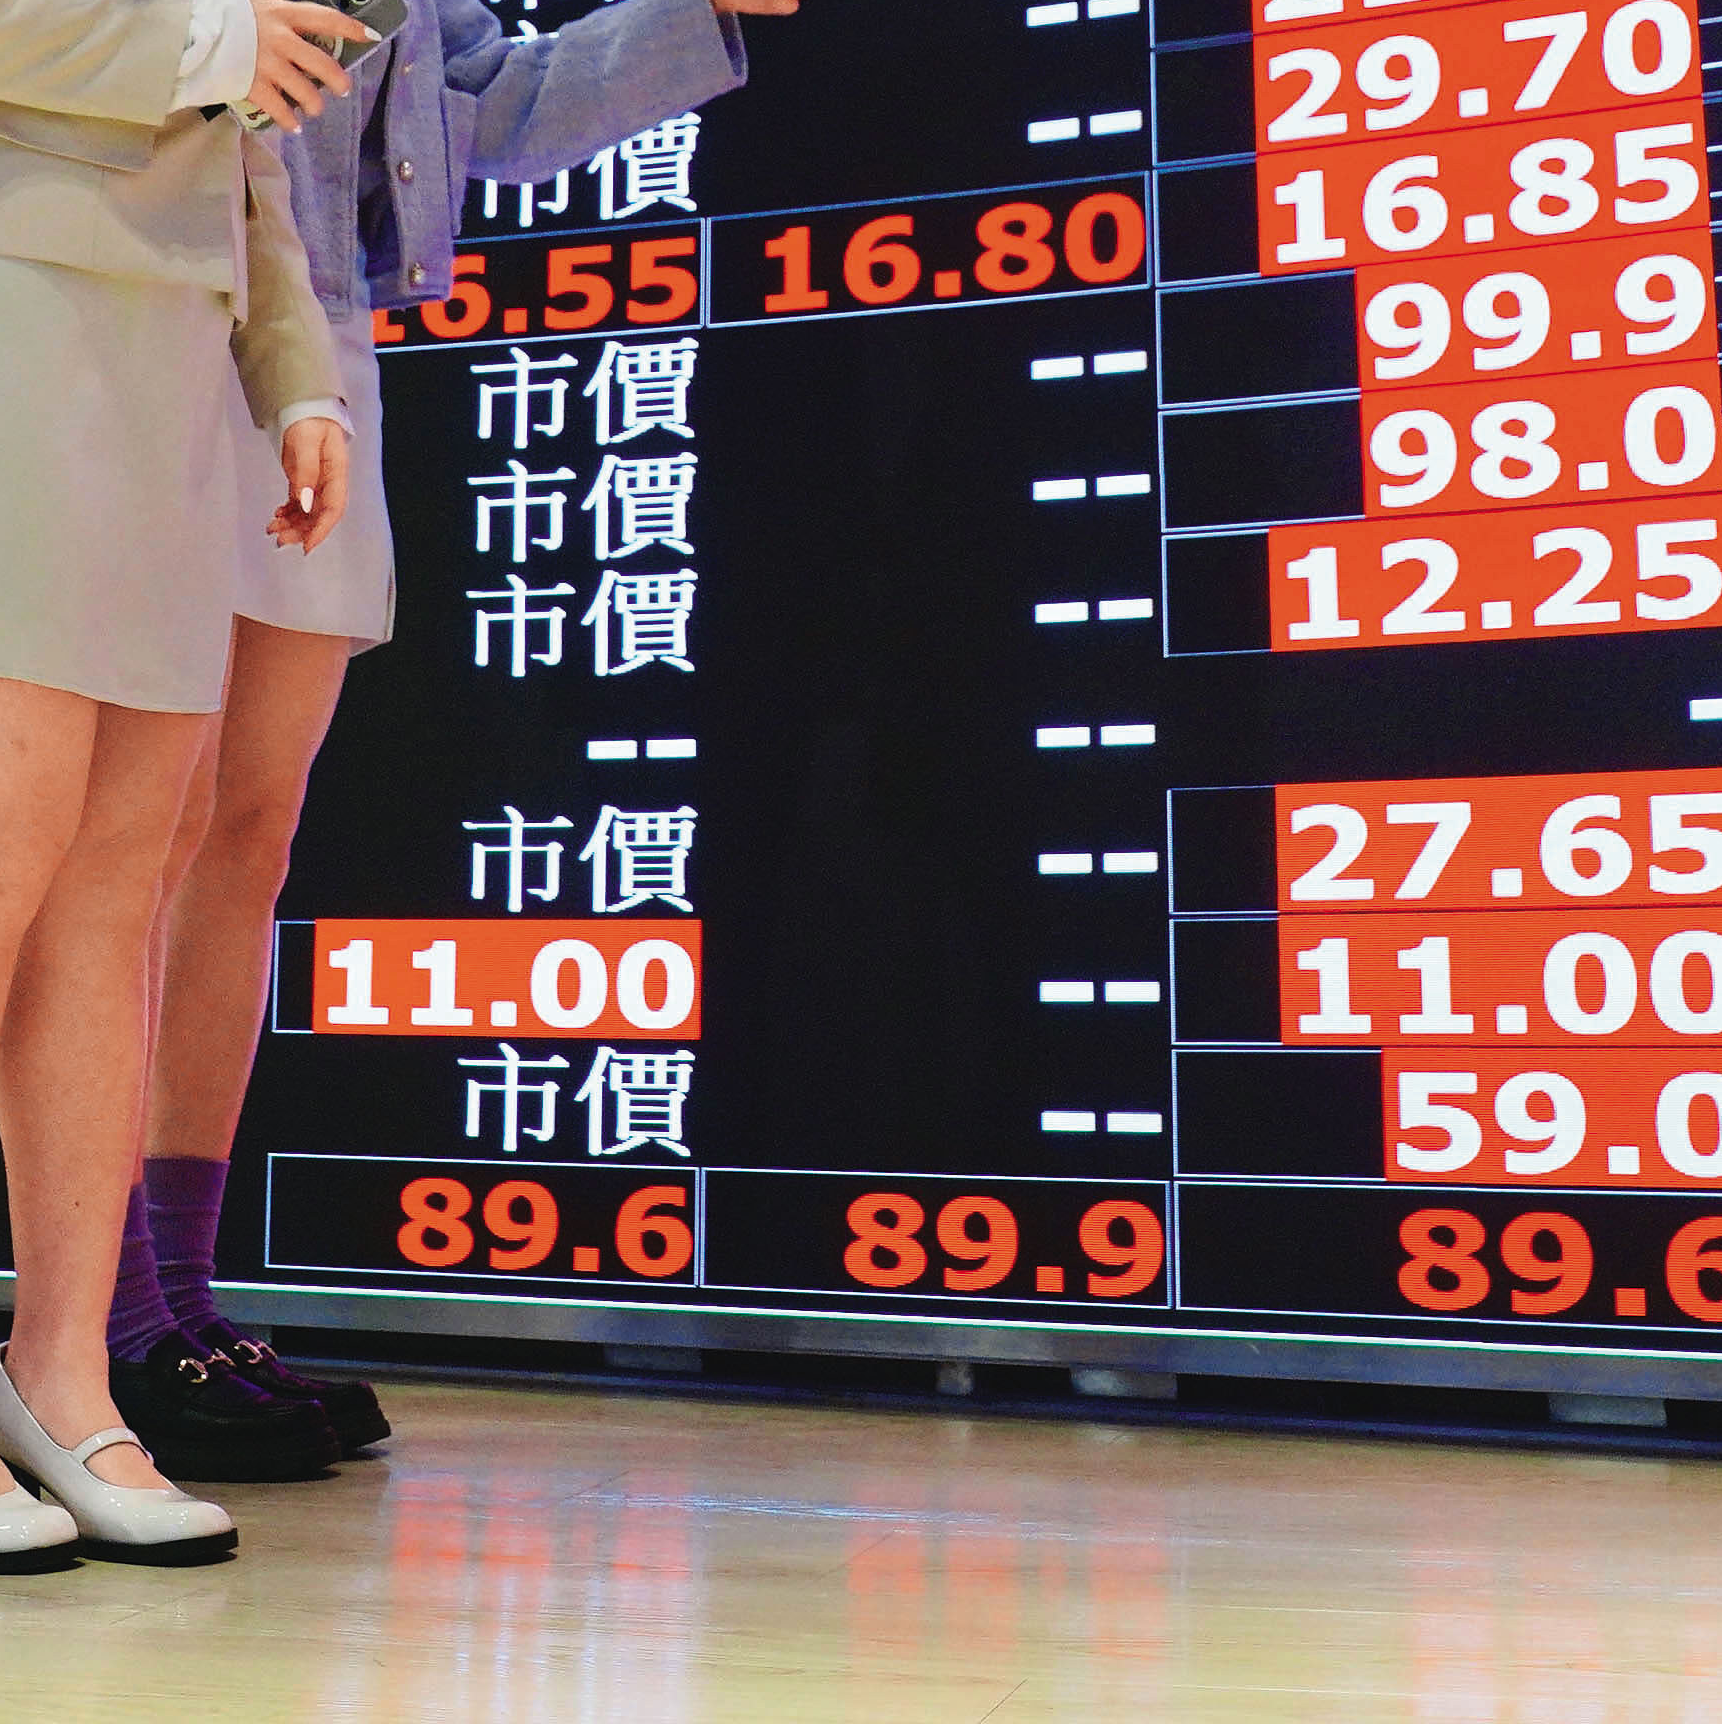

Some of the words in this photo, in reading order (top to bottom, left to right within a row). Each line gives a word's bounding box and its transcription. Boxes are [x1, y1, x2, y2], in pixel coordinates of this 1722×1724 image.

[1268, 0, 1691, 142] 29.70
[765, 193, 1145, 312] 16.80
[1275, 123, 1699, 264] 16.85
[467, 338, 699, 448] 市價
[1370, 386, 1715, 507] 98.0
[1287, 520, 1722, 640] 12.25
[328, 939, 695, 1029] 11.00
[397, 1178, 693, 1277] 89.6
[844, 1194, 1164, 1297] 89.9
